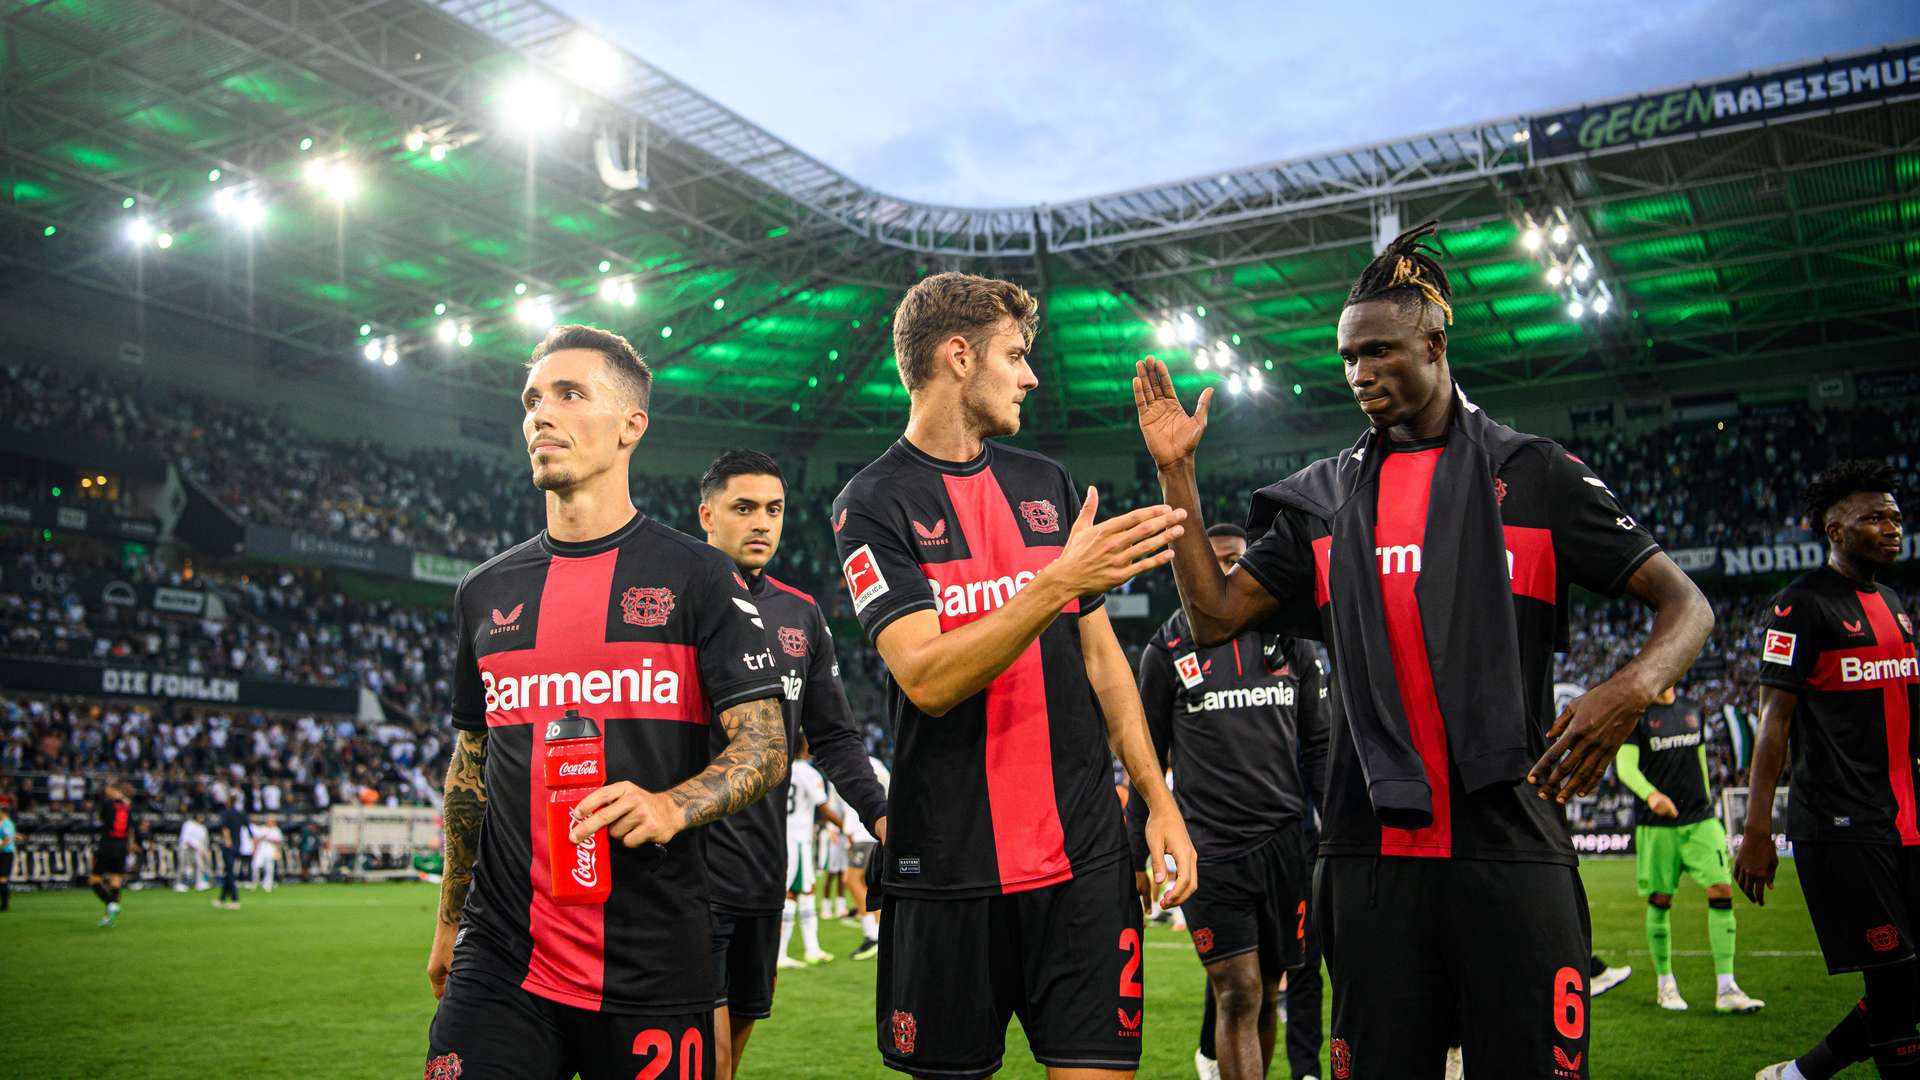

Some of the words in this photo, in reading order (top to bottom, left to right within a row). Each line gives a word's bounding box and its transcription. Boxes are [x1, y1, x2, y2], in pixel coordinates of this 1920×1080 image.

[1578, 87, 1717, 149] GEGEN
[1722, 542, 1824, 576] NORD
[928, 569, 1037, 617] Barme
[103, 669, 147, 694] DIE
[481, 658, 679, 712] Barmenia
[743, 648, 776, 670] tri
[1118, 927, 1142, 998] 2
[1553, 966, 1585, 1040] 6
[632, 1026, 703, 1080] 20
